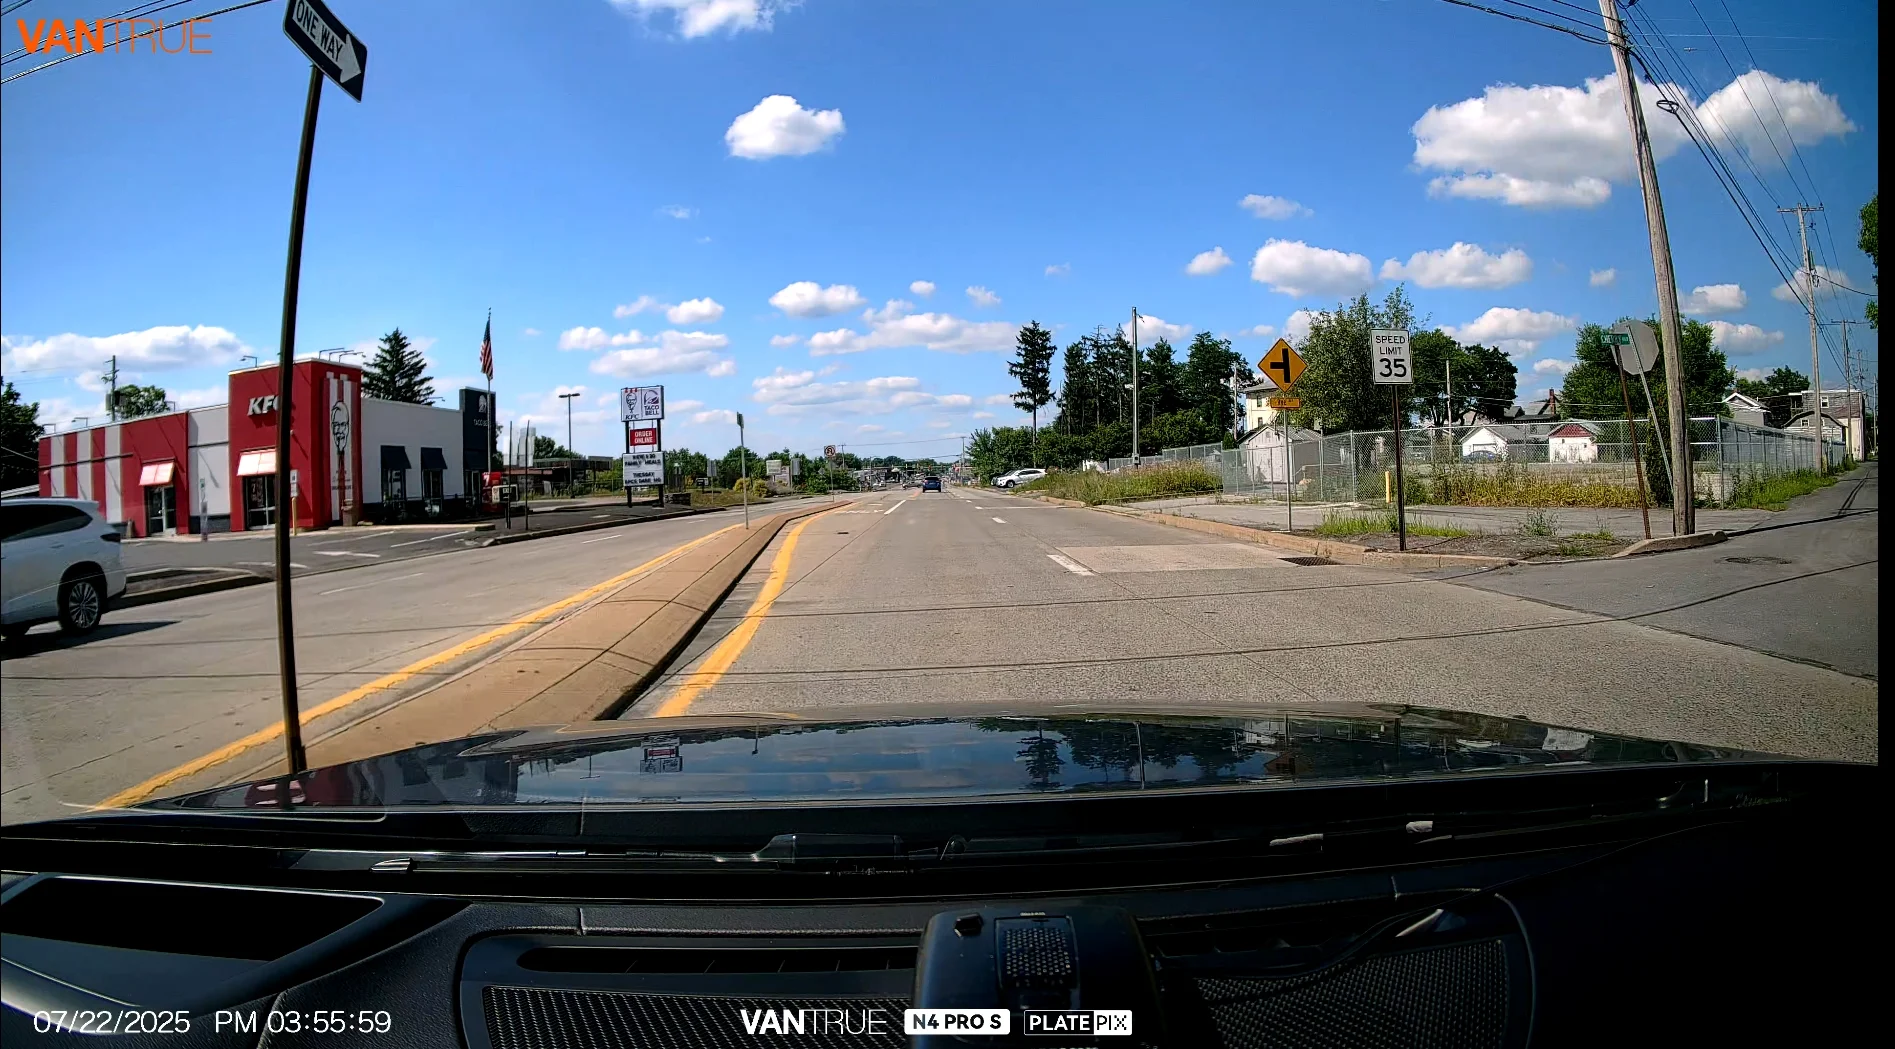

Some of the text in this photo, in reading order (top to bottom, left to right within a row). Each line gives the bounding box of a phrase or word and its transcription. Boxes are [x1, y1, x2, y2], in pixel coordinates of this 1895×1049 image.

[297, 0, 343, 62] ONE WAY
[1375, 335, 1406, 344] SPEED
[1379, 346, 1402, 355] LIMIT
[1379, 357, 1407, 378] 35
[634, 430, 653, 438] ORDER
[634, 436, 653, 444] ONLINE
